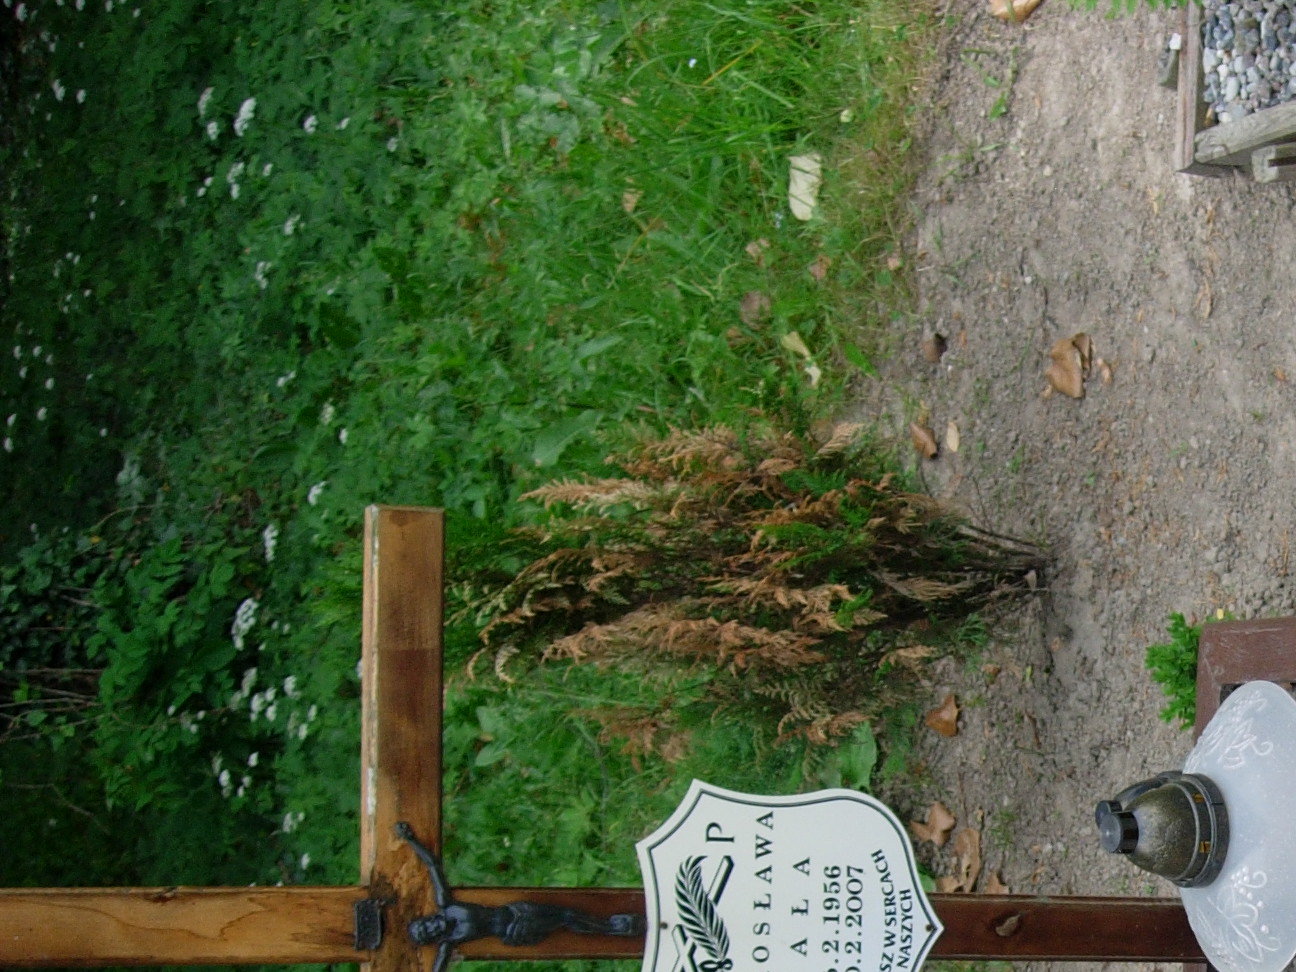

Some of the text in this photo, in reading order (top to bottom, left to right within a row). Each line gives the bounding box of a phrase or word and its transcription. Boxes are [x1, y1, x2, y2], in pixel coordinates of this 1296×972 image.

[705, 821, 735, 843] P
[870, 848, 898, 930] SERCACH
[884, 930, 897, 949] W
[896, 888, 913, 970] NASZYCH
